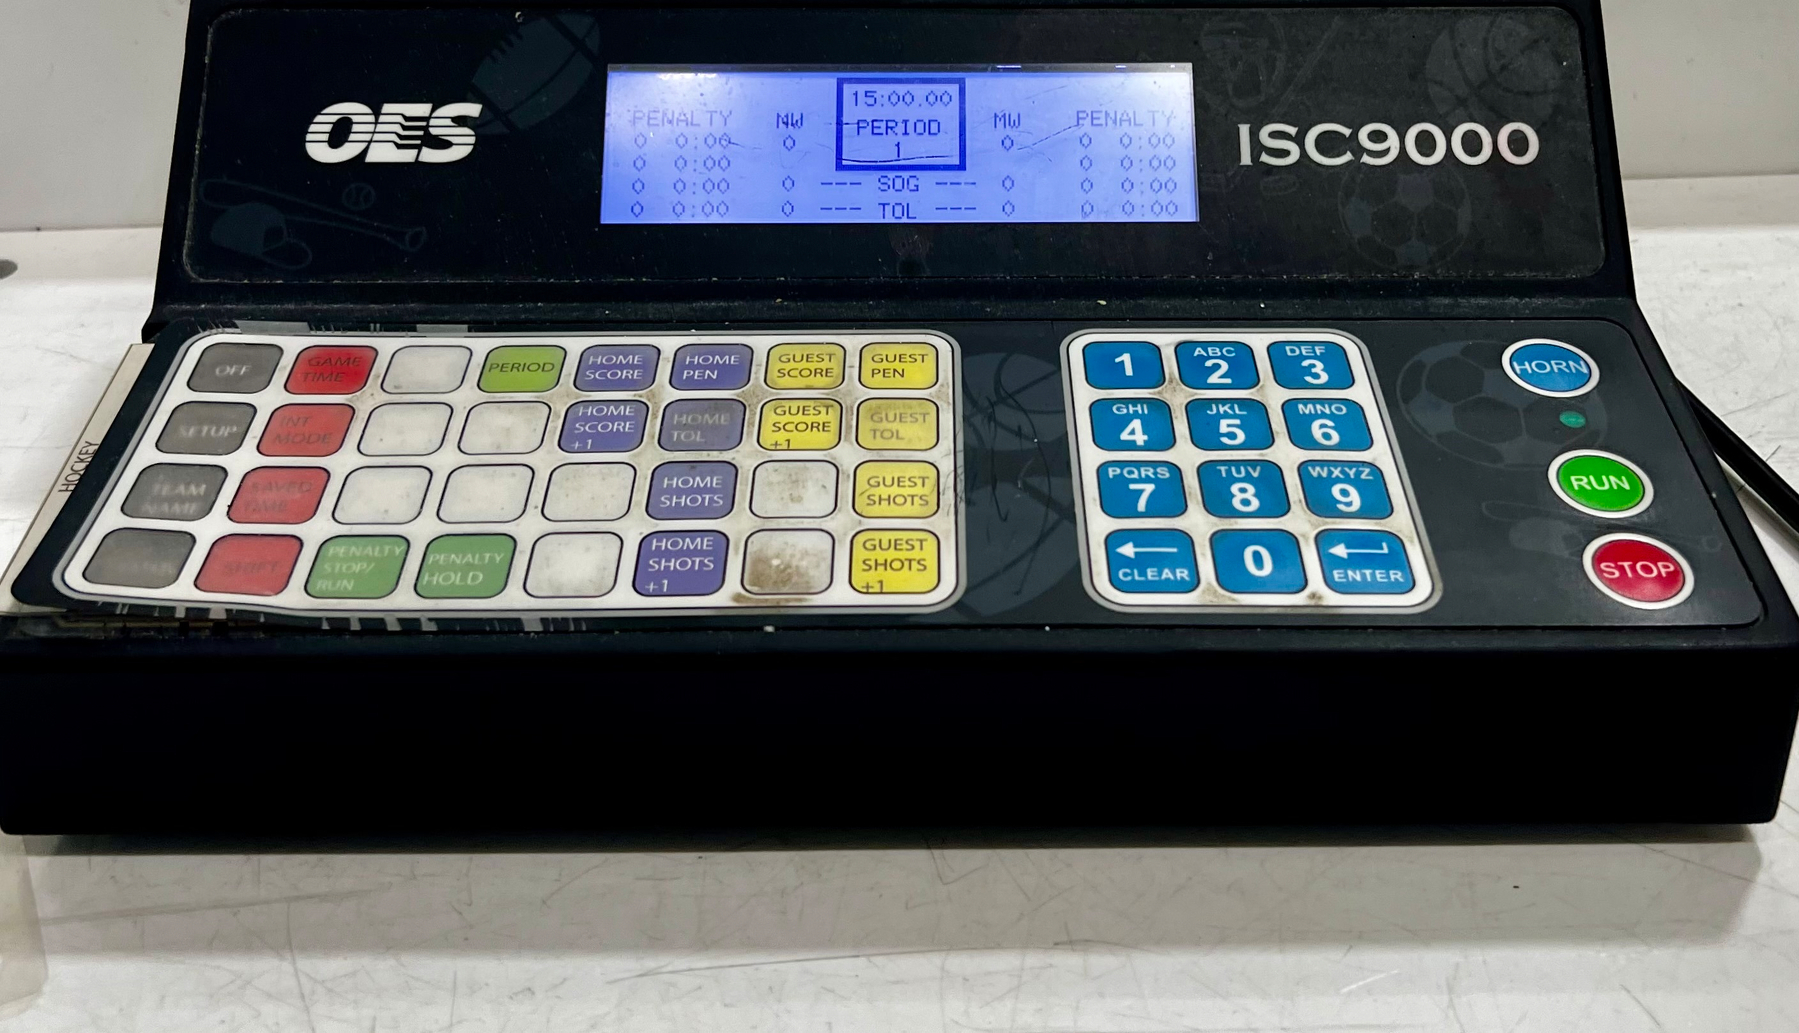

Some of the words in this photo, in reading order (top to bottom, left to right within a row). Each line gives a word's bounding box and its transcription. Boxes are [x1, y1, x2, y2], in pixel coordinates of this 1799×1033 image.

[852, 90, 952, 107] 15:00.00
[632, 110, 732, 127] PENALTY
[994, 112, 1021, 129] MW
[1076, 110, 1176, 127] PENALTY
[305, 101, 483, 163] OES
[856, 119, 941, 136] PERIOD
[894, 141, 901, 158] 1
[1237, 122, 1540, 166] ISC9000
[878, 175, 920, 192] SOG
[878, 202, 917, 220] TOL
[778, 353, 836, 363] GUEST
[1193, 347, 1236, 357] ABC
[1285, 346, 1326, 357] DEF
[308, 356, 362, 367] GAME
[588, 355, 644, 365] HOME
[685, 354, 740, 365] HOME
[871, 354, 928, 363] GUEST
[1114, 353, 1134, 376] 1
[215, 364, 250, 377] OFF
[487, 361, 555, 373] PERIOD
[776, 368, 834, 378] SCORE
[871, 368, 905, 378] PEN
[1204, 359, 1232, 384] 2
[1300, 359, 1329, 385] 3
[1512, 360, 1590, 375] HORN
[302, 372, 345, 383] TIME
[584, 369, 643, 380] SCORE
[682, 369, 718, 380] PEN
[578, 405, 635, 416] HOME
[773, 405, 834, 416] GUEST
[1112, 403, 1148, 415] GHI
[1206, 403, 1247, 415] JKL
[1297, 403, 1347, 415] MNO
[280, 417, 309, 428] INT
[672, 413, 730, 425] HOME
[870, 412, 930, 423] GUEST
[179, 424, 238, 438] SETUP
[574, 421, 635, 433] SCORE
[771, 421, 831, 432] SCORE
[1119, 419, 1149, 446] 4
[1218, 419, 1246, 446] 5
[1310, 418, 1341, 446] 6
[274, 432, 332, 445] MODE
[671, 430, 705, 442] TOL
[870, 429, 905, 440] TOL
[571, 439, 592, 450] +1
[770, 439, 791, 449] +1
[58, 440, 100, 492] HOCKEY
[1216, 466, 1262, 478] TUV
[1108, 467, 1170, 480] PQRS
[1308, 466, 1374, 480] WXYZ
[663, 476, 723, 489] HOME
[867, 476, 930, 488] GUEST
[1569, 475, 1631, 491] RUN
[660, 494, 723, 507] SHOTS
[866, 494, 929, 507] SHOTS
[1128, 483, 1156, 513] 7
[1229, 482, 1260, 512] 8
[1330, 483, 1362, 512] 9
[652, 538, 714, 551] HOME
[862, 538, 928, 551] GUEST
[328, 545, 404, 558] PENALTY
[428, 552, 505, 565] PENALTY
[648, 557, 715, 571] SHOTS
[861, 558, 927, 572] SHOTS
[1242, 544, 1273, 577] 0
[323, 562, 376, 574] STOP/
[1600, 561, 1676, 580] STOP
[422, 571, 483, 586] HOLD
[1117, 568, 1190, 582] CLEAR
[1332, 569, 1404, 582] ENTER
[316, 579, 355, 591] RUN
[645, 580, 668, 593] +1
[861, 580, 884, 592] +1
